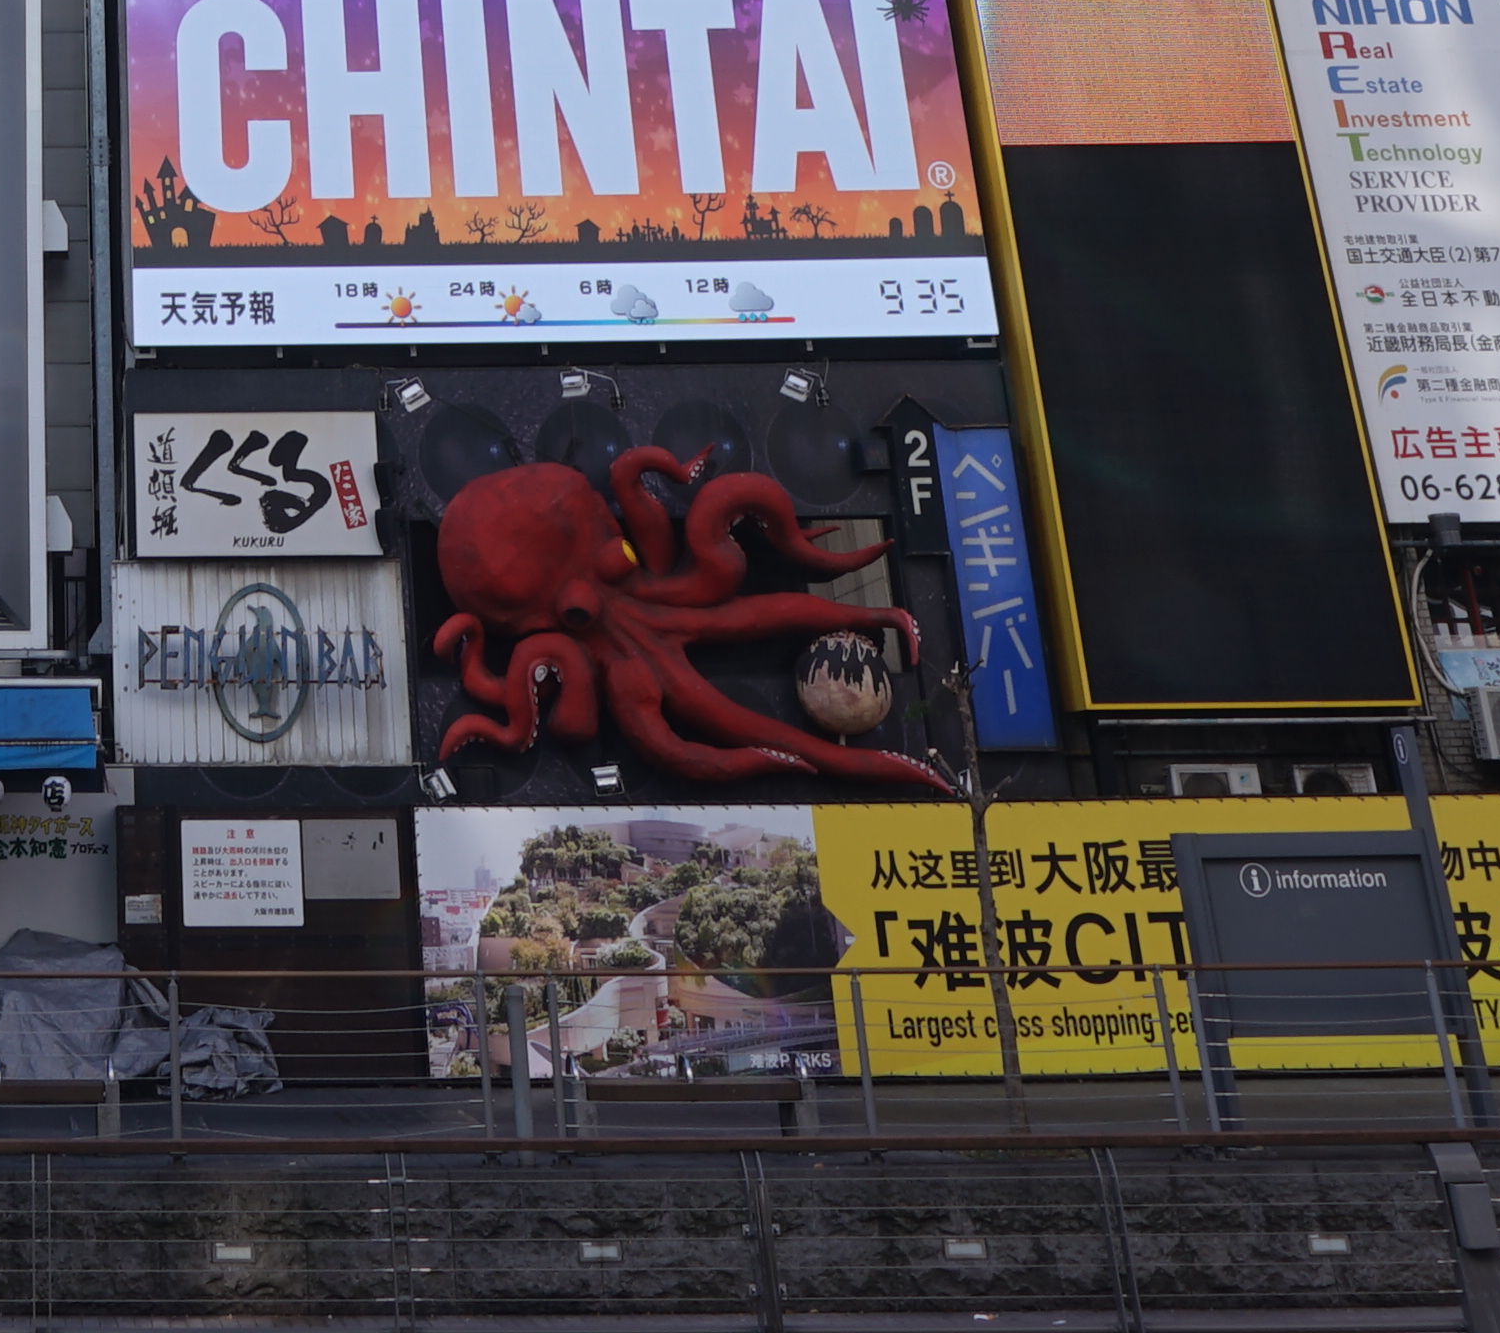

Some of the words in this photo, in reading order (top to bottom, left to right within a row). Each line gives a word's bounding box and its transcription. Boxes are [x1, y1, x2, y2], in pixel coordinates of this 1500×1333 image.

[1318, 31, 1394, 60] Real
[1327, 65, 1424, 95] Estate
[1334, 99, 1472, 129] Investment
[1336, 133, 1483, 165] Technology
[1349, 170, 1455, 191] SERVICE
[1356, 193, 1482, 215] PROVIDER
[1343, 234, 1419, 245] 宅地建物取引業
[334, 281, 379, 300] 18時
[449, 280, 496, 298] 24時
[580, 279, 613, 296] 6時
[685, 277, 730, 295] 12時
[1399, 278, 1464, 289] 公益社団法人
[160, 290, 276, 327] 天気予報
[1363, 322, 1473, 333] 第二種金融商品取引業
[233, 536, 285, 548] KUKURU
[950, 451, 1033, 718] ペンギンバー
[317, 625, 387, 690] BAR
[1274, 868, 1388, 891] information
[887, 1007, 975, 1047] Largest
[1052, 1005, 1156, 1044] shopping
